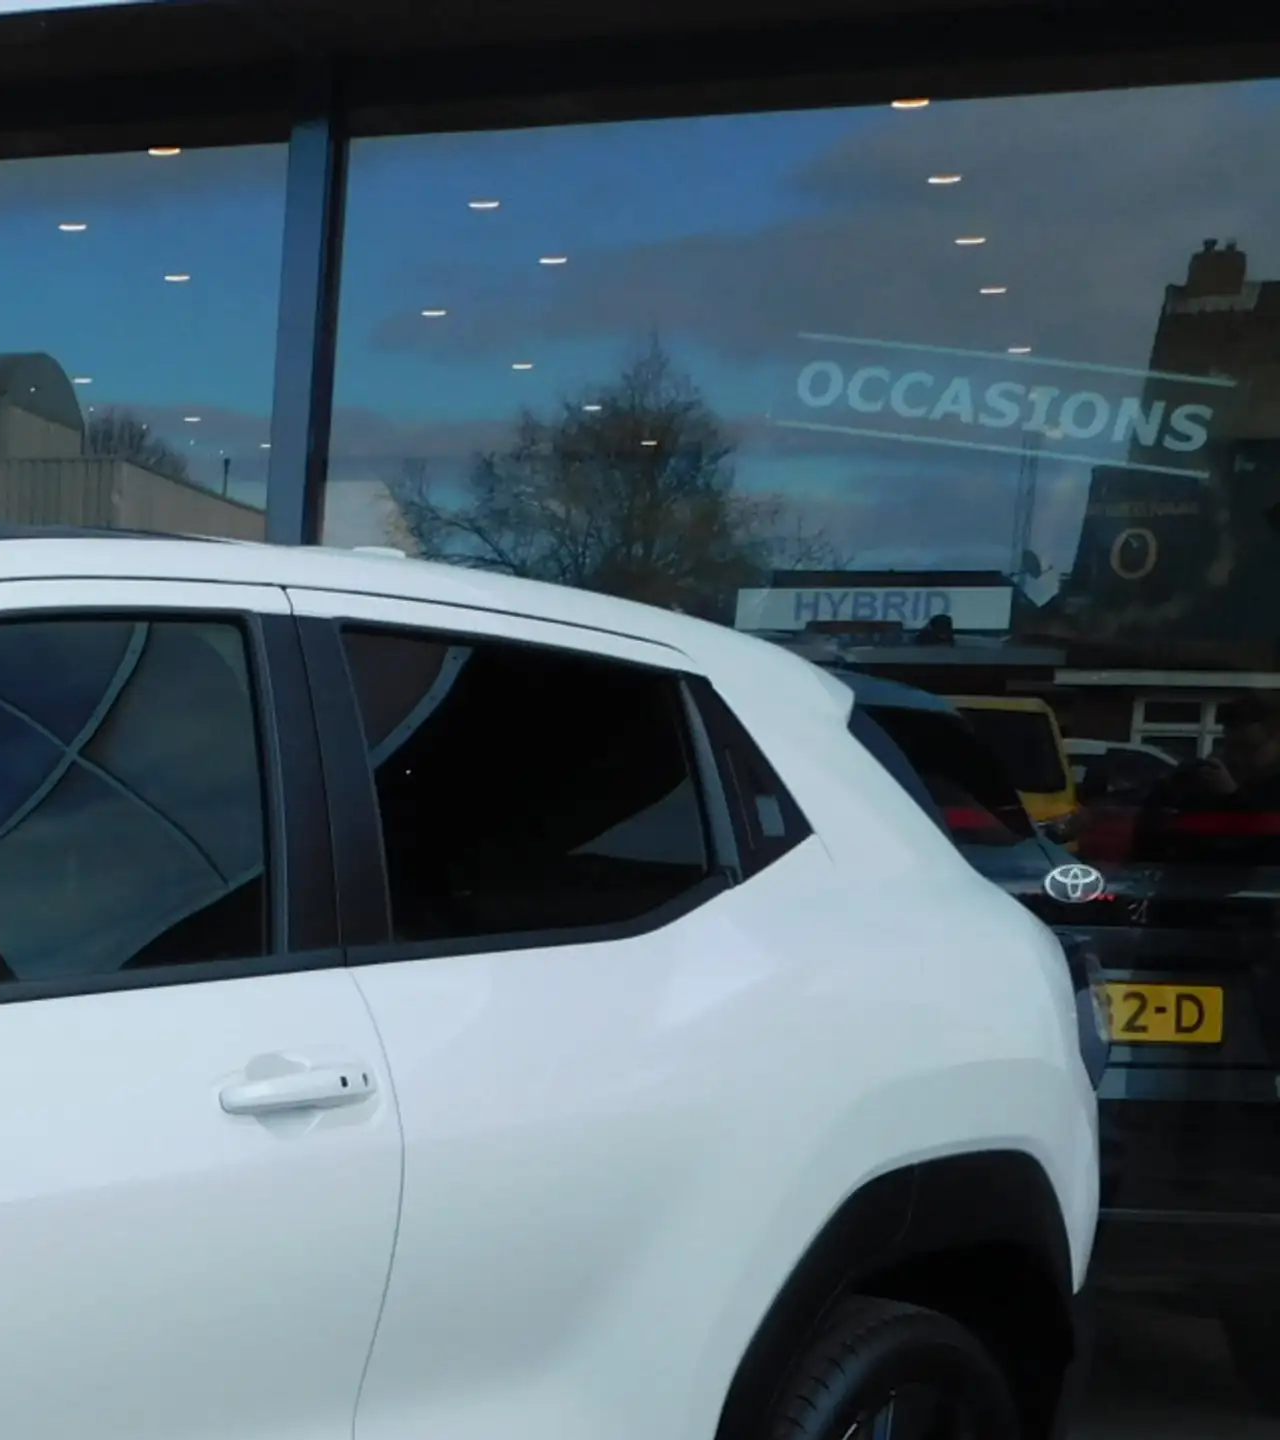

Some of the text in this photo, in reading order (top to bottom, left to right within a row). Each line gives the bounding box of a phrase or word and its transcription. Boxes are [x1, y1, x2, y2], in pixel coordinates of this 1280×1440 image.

[797, 360, 1214, 453] OCCASIONS
[794, 590, 953, 624] HYBRID
[1104, 990, 1206, 1035] 2-D
